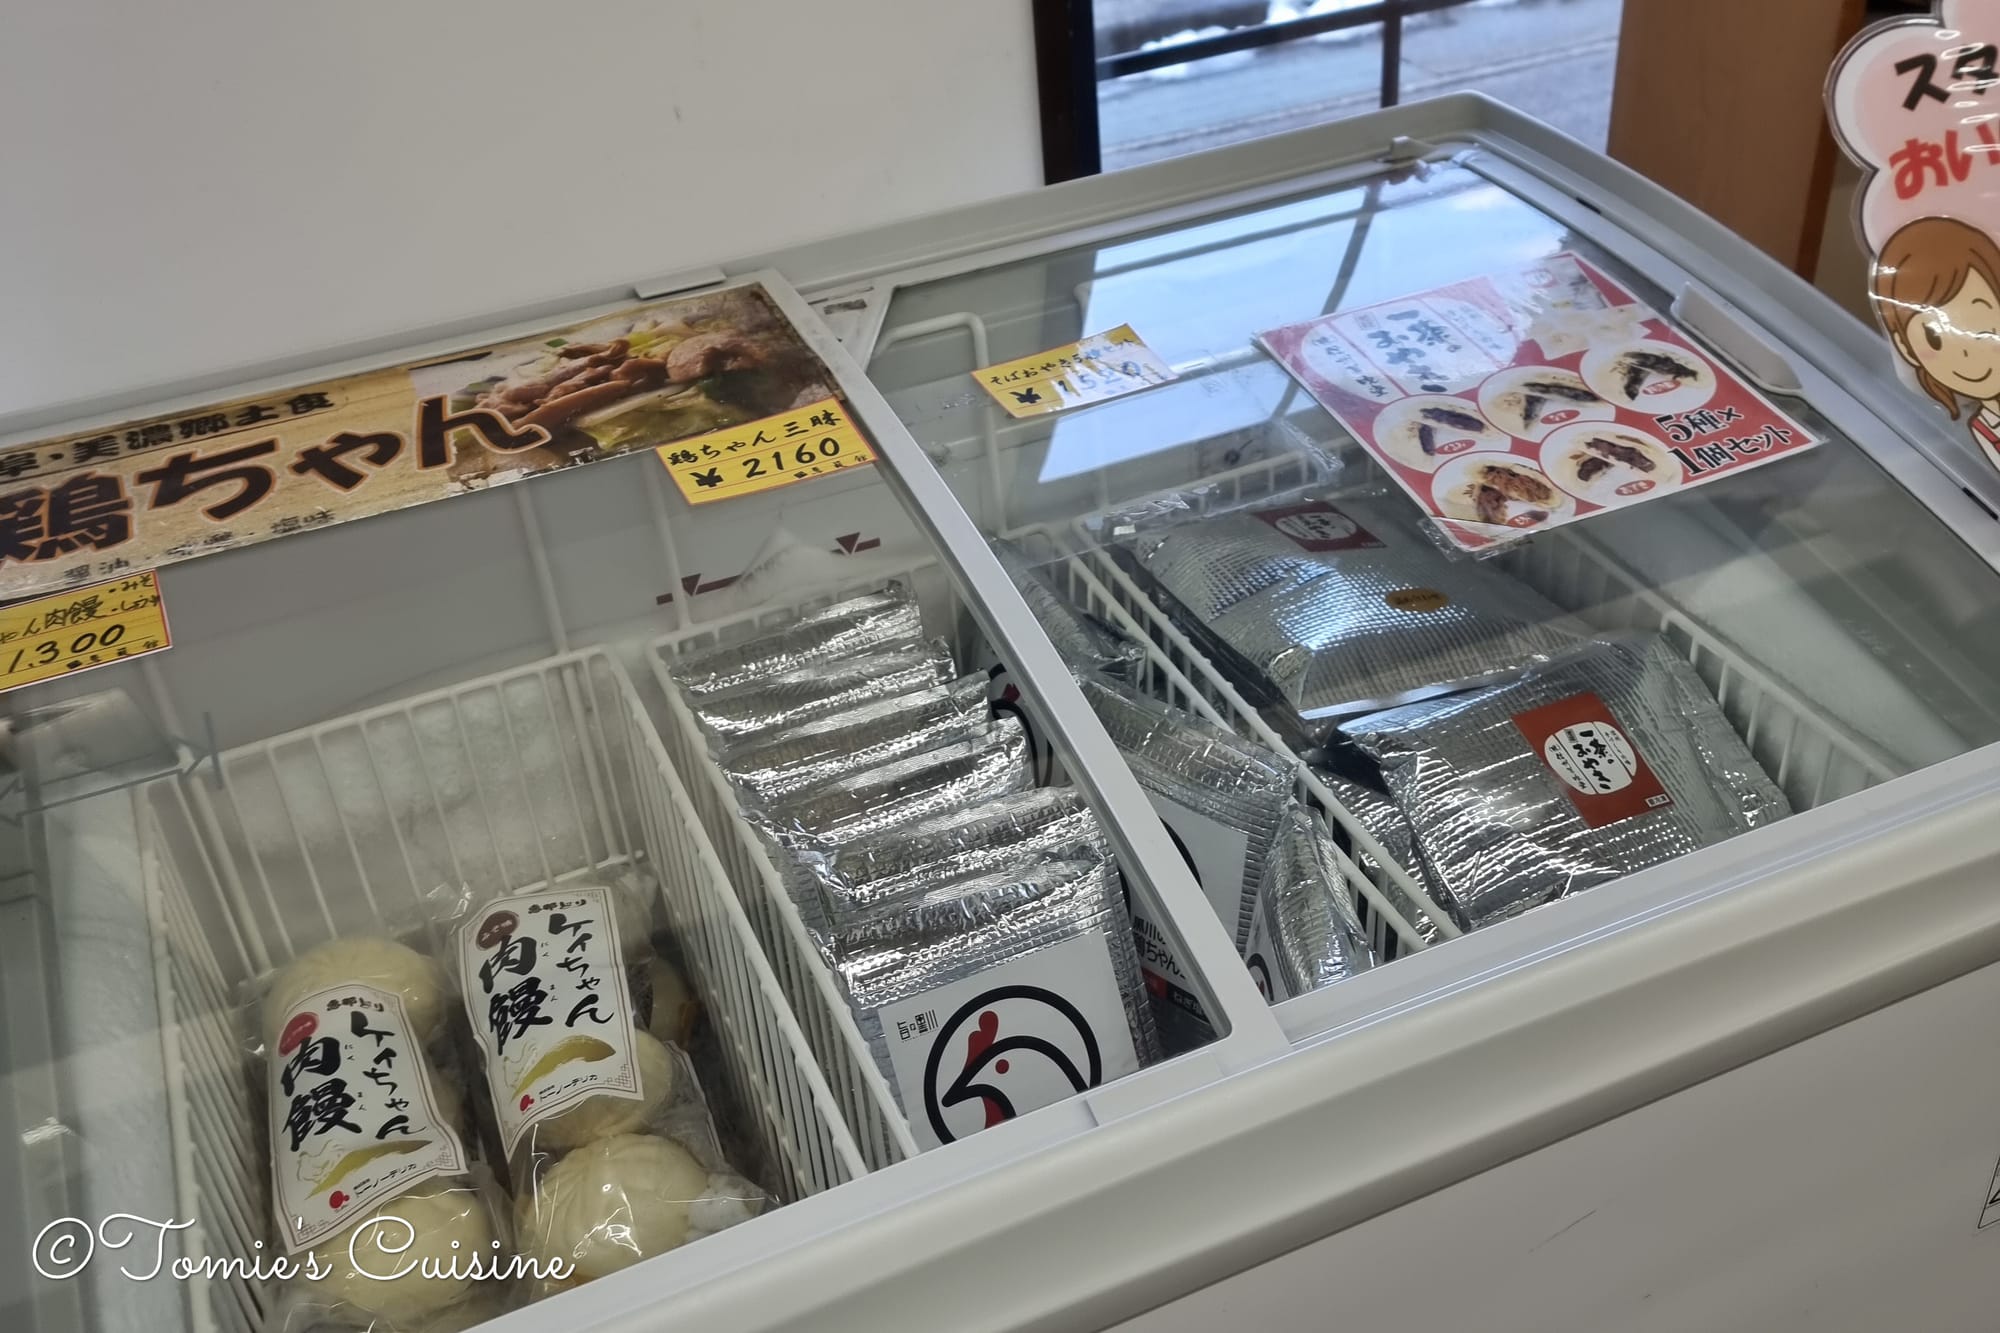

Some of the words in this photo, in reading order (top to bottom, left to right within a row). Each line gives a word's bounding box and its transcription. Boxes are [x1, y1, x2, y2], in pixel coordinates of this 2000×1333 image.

[0, 394, 551, 563] 鶏ちゃん
[1667, 425, 1791, 475] 1個セット
